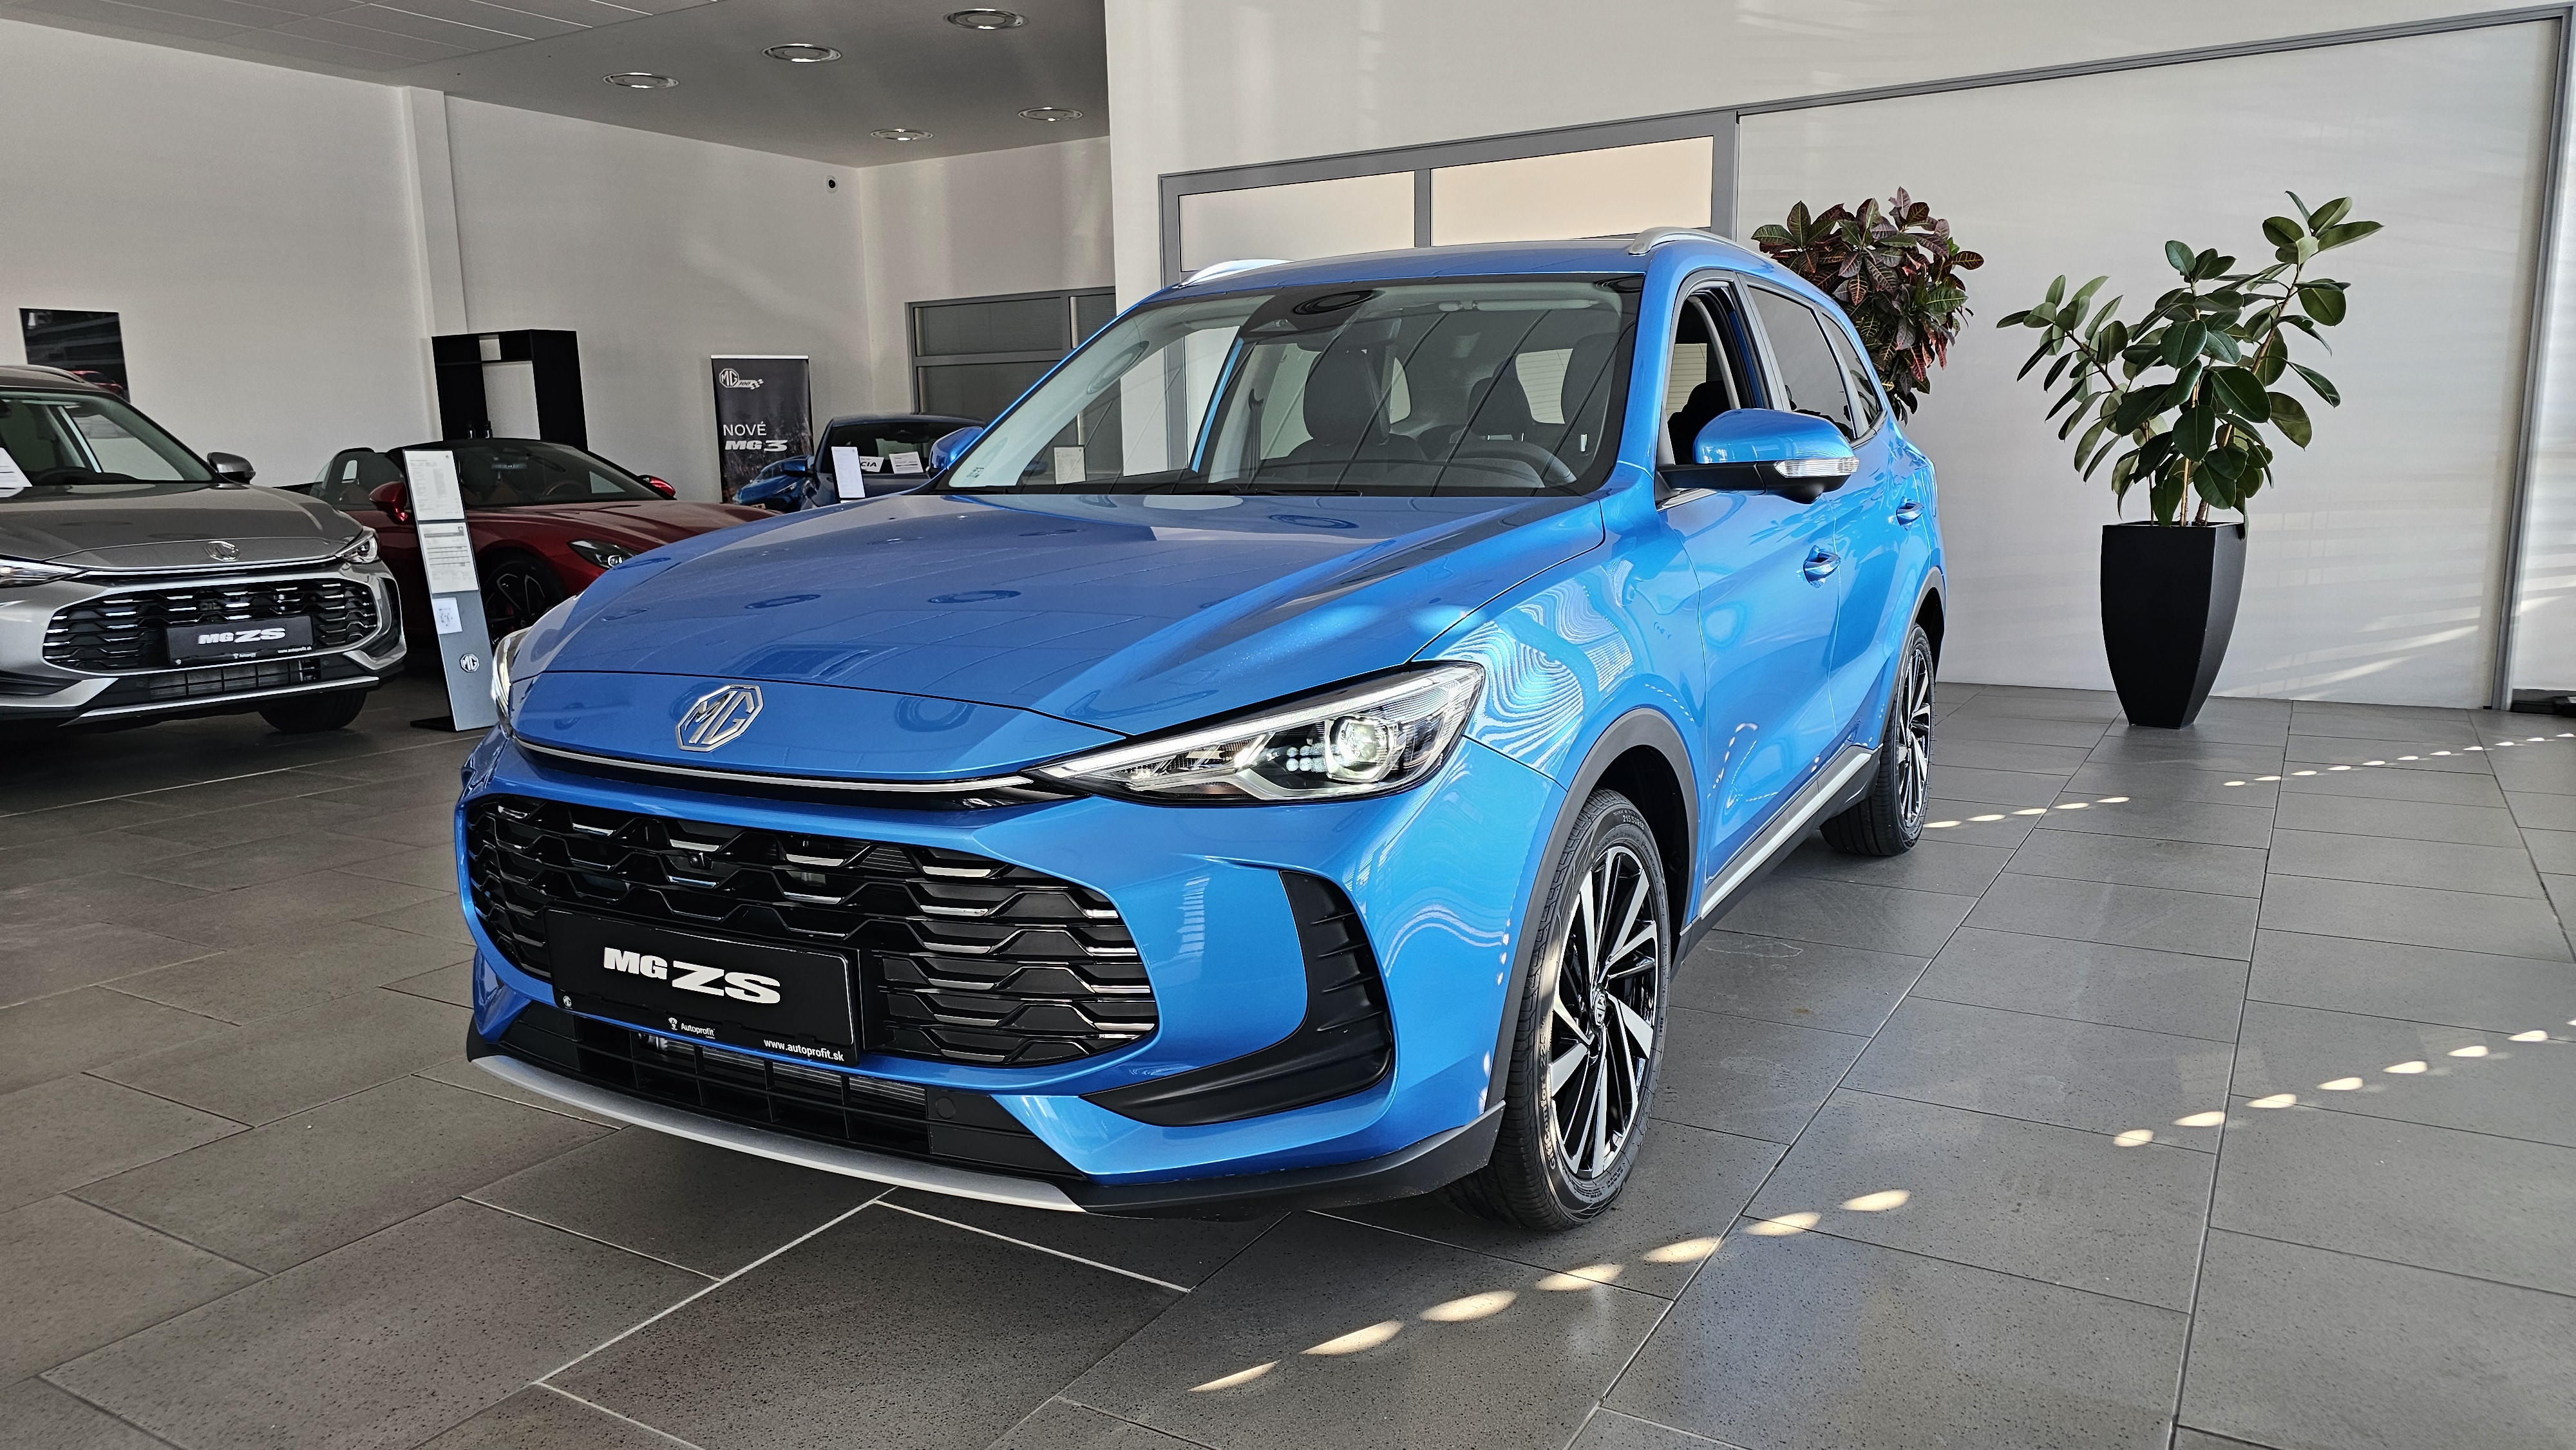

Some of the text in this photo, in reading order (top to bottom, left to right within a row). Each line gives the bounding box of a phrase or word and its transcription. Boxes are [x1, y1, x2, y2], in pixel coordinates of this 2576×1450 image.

[720, 369, 739, 386] MG
[723, 421, 767, 436] NOVÉ
[198, 628, 286, 645] MG ZS
[461, 654, 479, 672] MG
[683, 689, 756, 746] MG
[603, 946, 781, 1004] MG ZS
[681, 1022, 715, 1037] Autoprofit
[763, 1039, 844, 1062] www.autoprofit.sk
